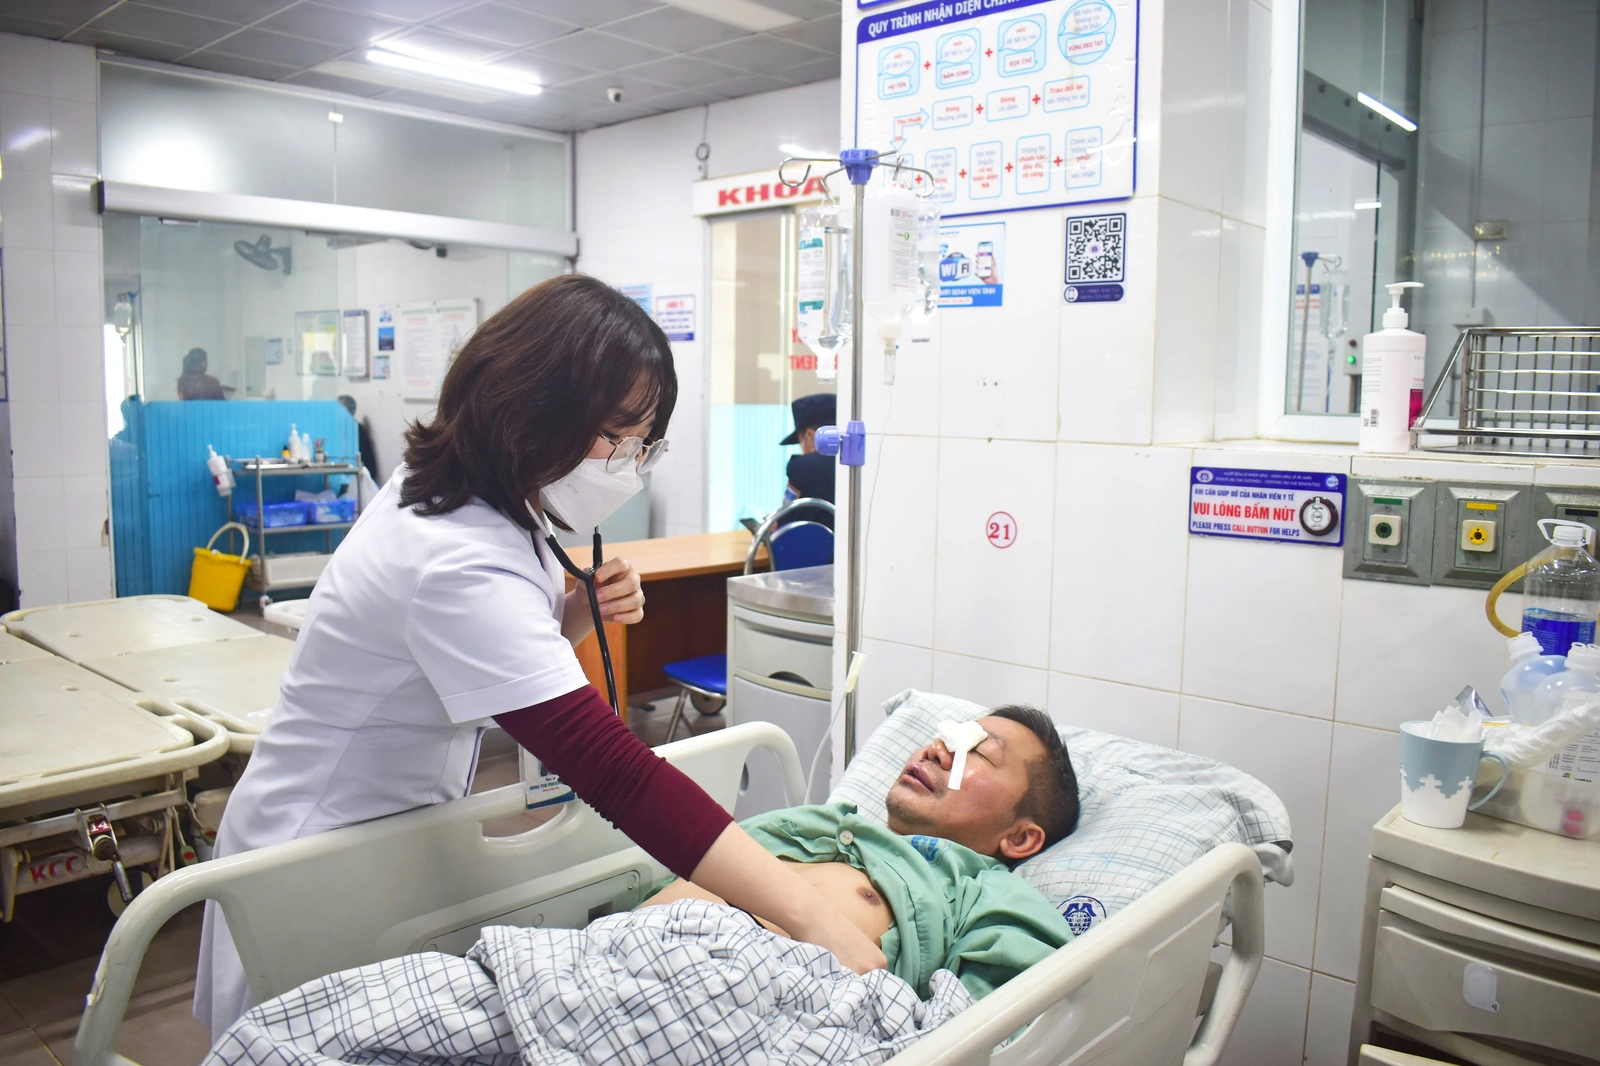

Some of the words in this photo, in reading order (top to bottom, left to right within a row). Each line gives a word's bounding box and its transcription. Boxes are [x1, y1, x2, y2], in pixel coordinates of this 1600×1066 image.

[868, 20, 889, 38] QUY
[890, 11, 922, 30] TRÌNH
[924, 4, 953, 22] NHẬN
[955, 0, 982, 15] DIỆN
[718, 176, 828, 207] KHOA
[1283, 493, 1287, 501] Y
[1193, 501, 1210, 515] VUI
[1213, 500, 1241, 518] LÒNG
[1244, 501, 1270, 520] BẤM
[1273, 505, 1296, 522] NÚT
[988, 522, 1010, 540] 21
[1192, 520, 1212, 530] PLEASE
[1213, 522, 1231, 531] PRESS
[1232, 524, 1245, 533] CALL
[1247, 524, 1268, 534] BUTTON
[1269, 527, 1280, 535] FOR
[1281, 528, 1300, 537] HELPS
[91, 819, 110, 833] 14
[30, 855, 80, 884] KCC
